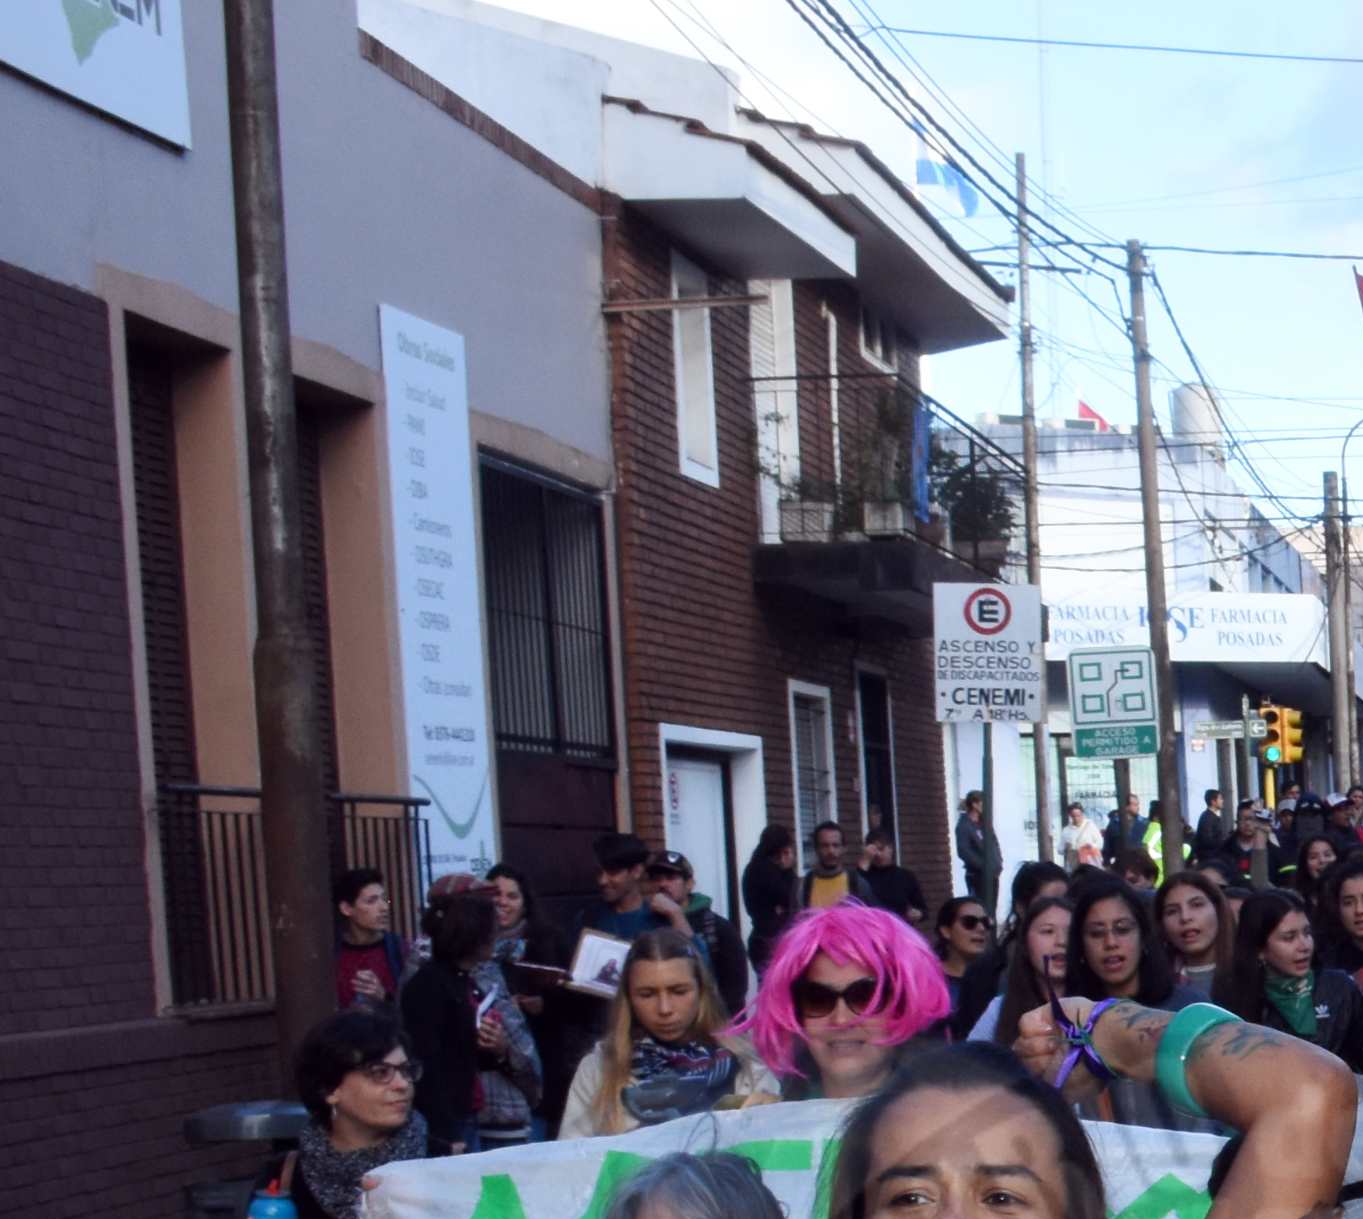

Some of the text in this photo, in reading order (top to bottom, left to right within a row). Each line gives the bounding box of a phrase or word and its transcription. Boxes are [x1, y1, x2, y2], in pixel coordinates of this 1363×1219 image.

[977, 599, 999, 623] E
[1210, 607, 1288, 625] FARMACIA
[938, 640, 1036, 654] ASCENSO Y
[1053, 629, 1283, 647] POSADAS POSADAS
[937, 656, 1032, 669] DESCENSO
[937, 670, 1041, 682] DE DISCAPACITADOS
[952, 688, 1026, 706] CENEMI
